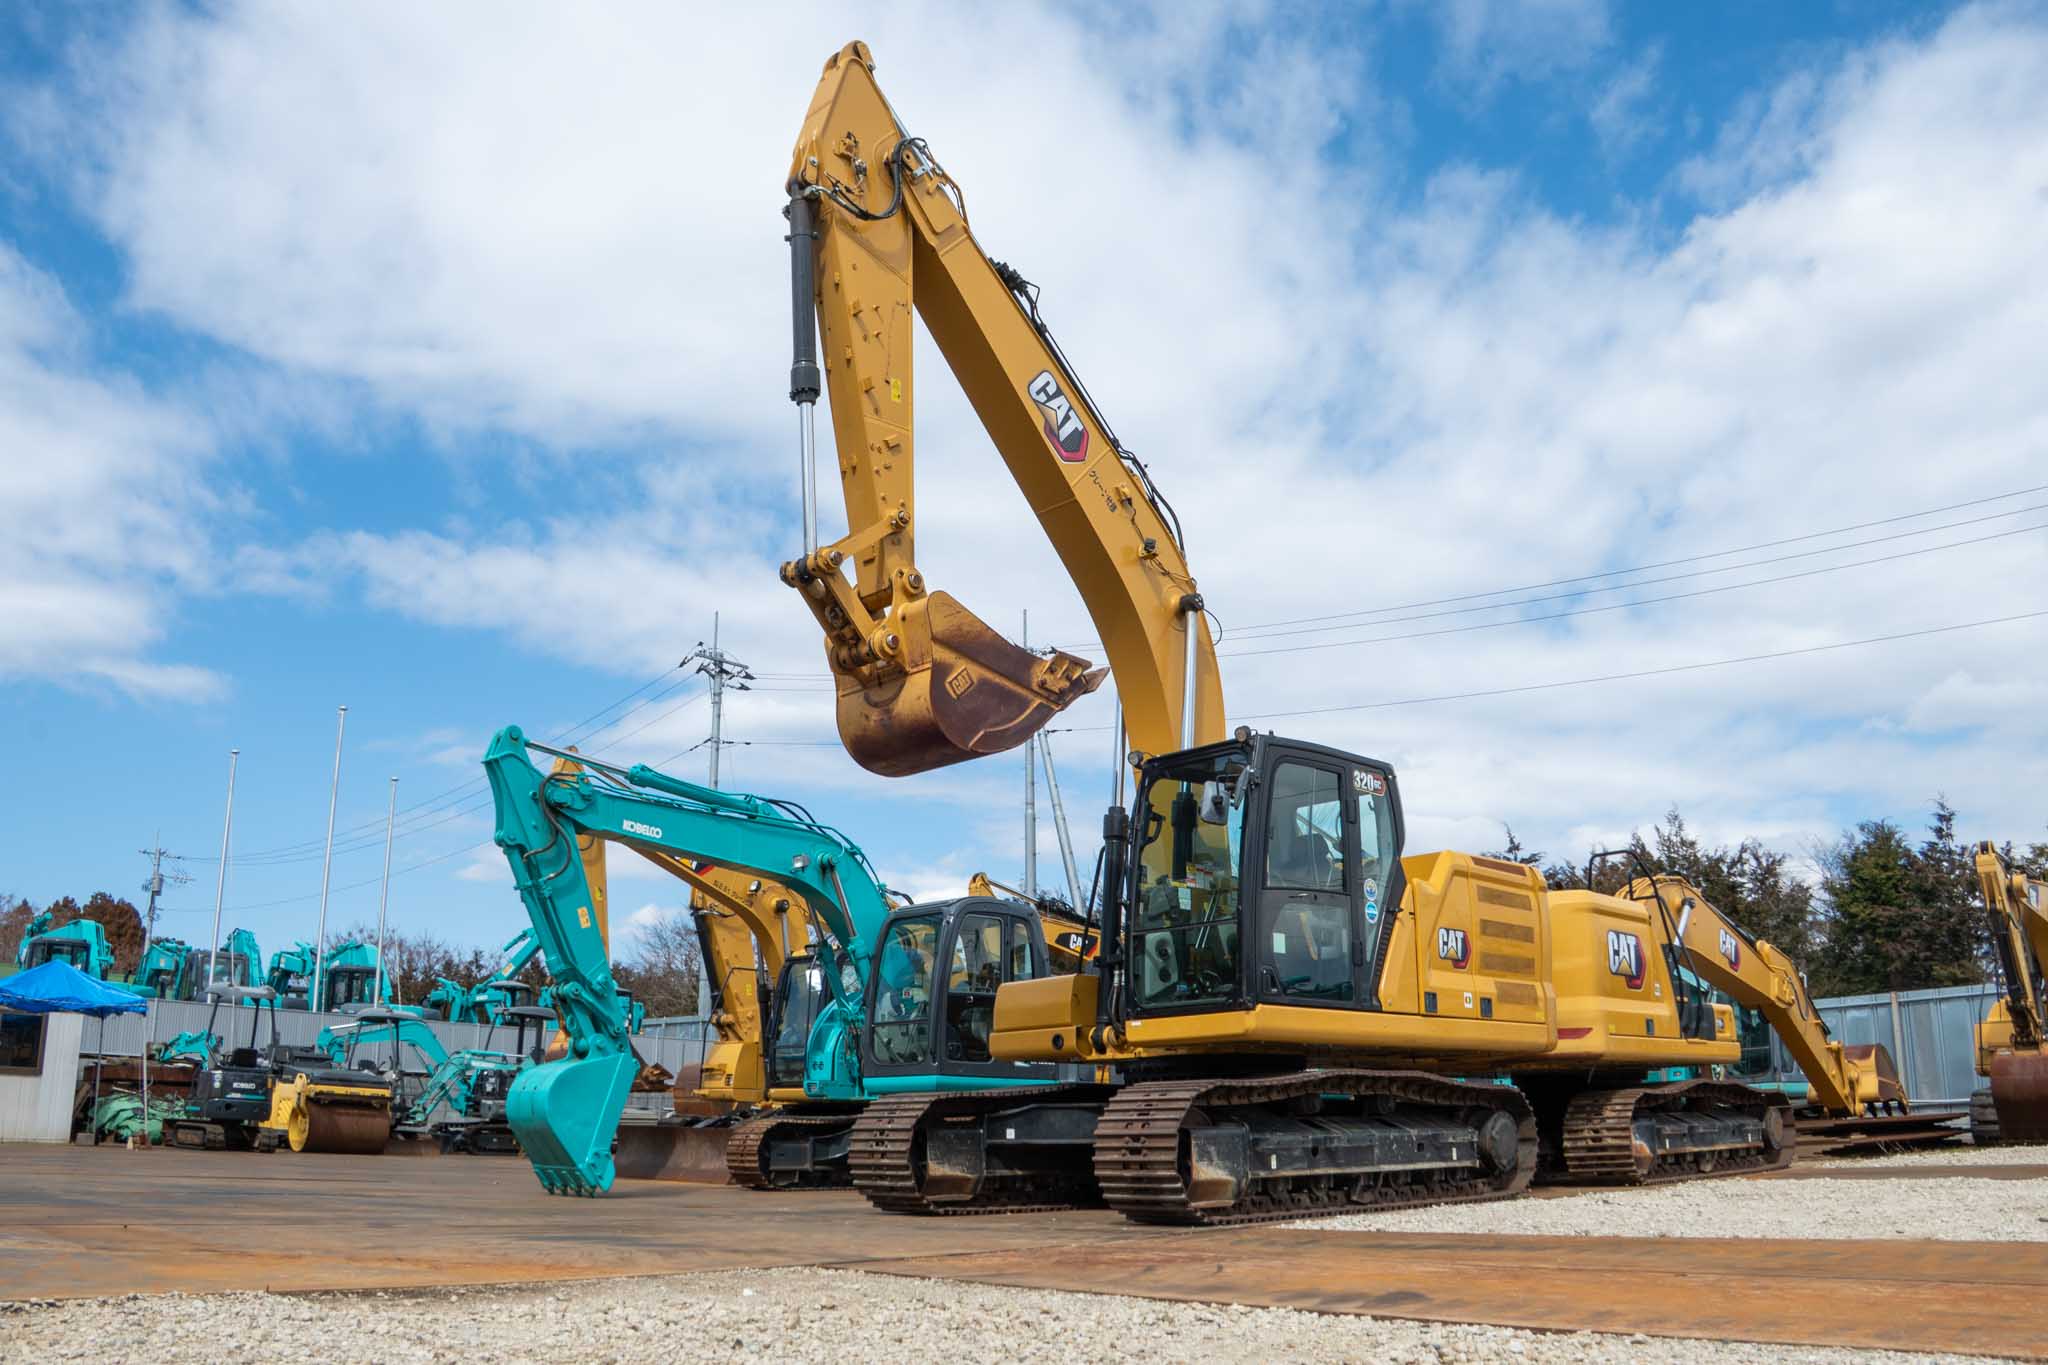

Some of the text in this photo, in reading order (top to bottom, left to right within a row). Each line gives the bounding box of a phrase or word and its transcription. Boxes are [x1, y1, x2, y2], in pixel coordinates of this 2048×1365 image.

[1028, 370, 1084, 443] CAT
[951, 669, 970, 694] CAT
[1353, 770, 1374, 791] 320
[622, 819, 663, 838] KOBELCO
[1069, 933, 1089, 950] CA
[1439, 928, 1464, 960] CAT
[1608, 931, 1637, 976] CAT
[1719, 928, 1737, 962] CAT
